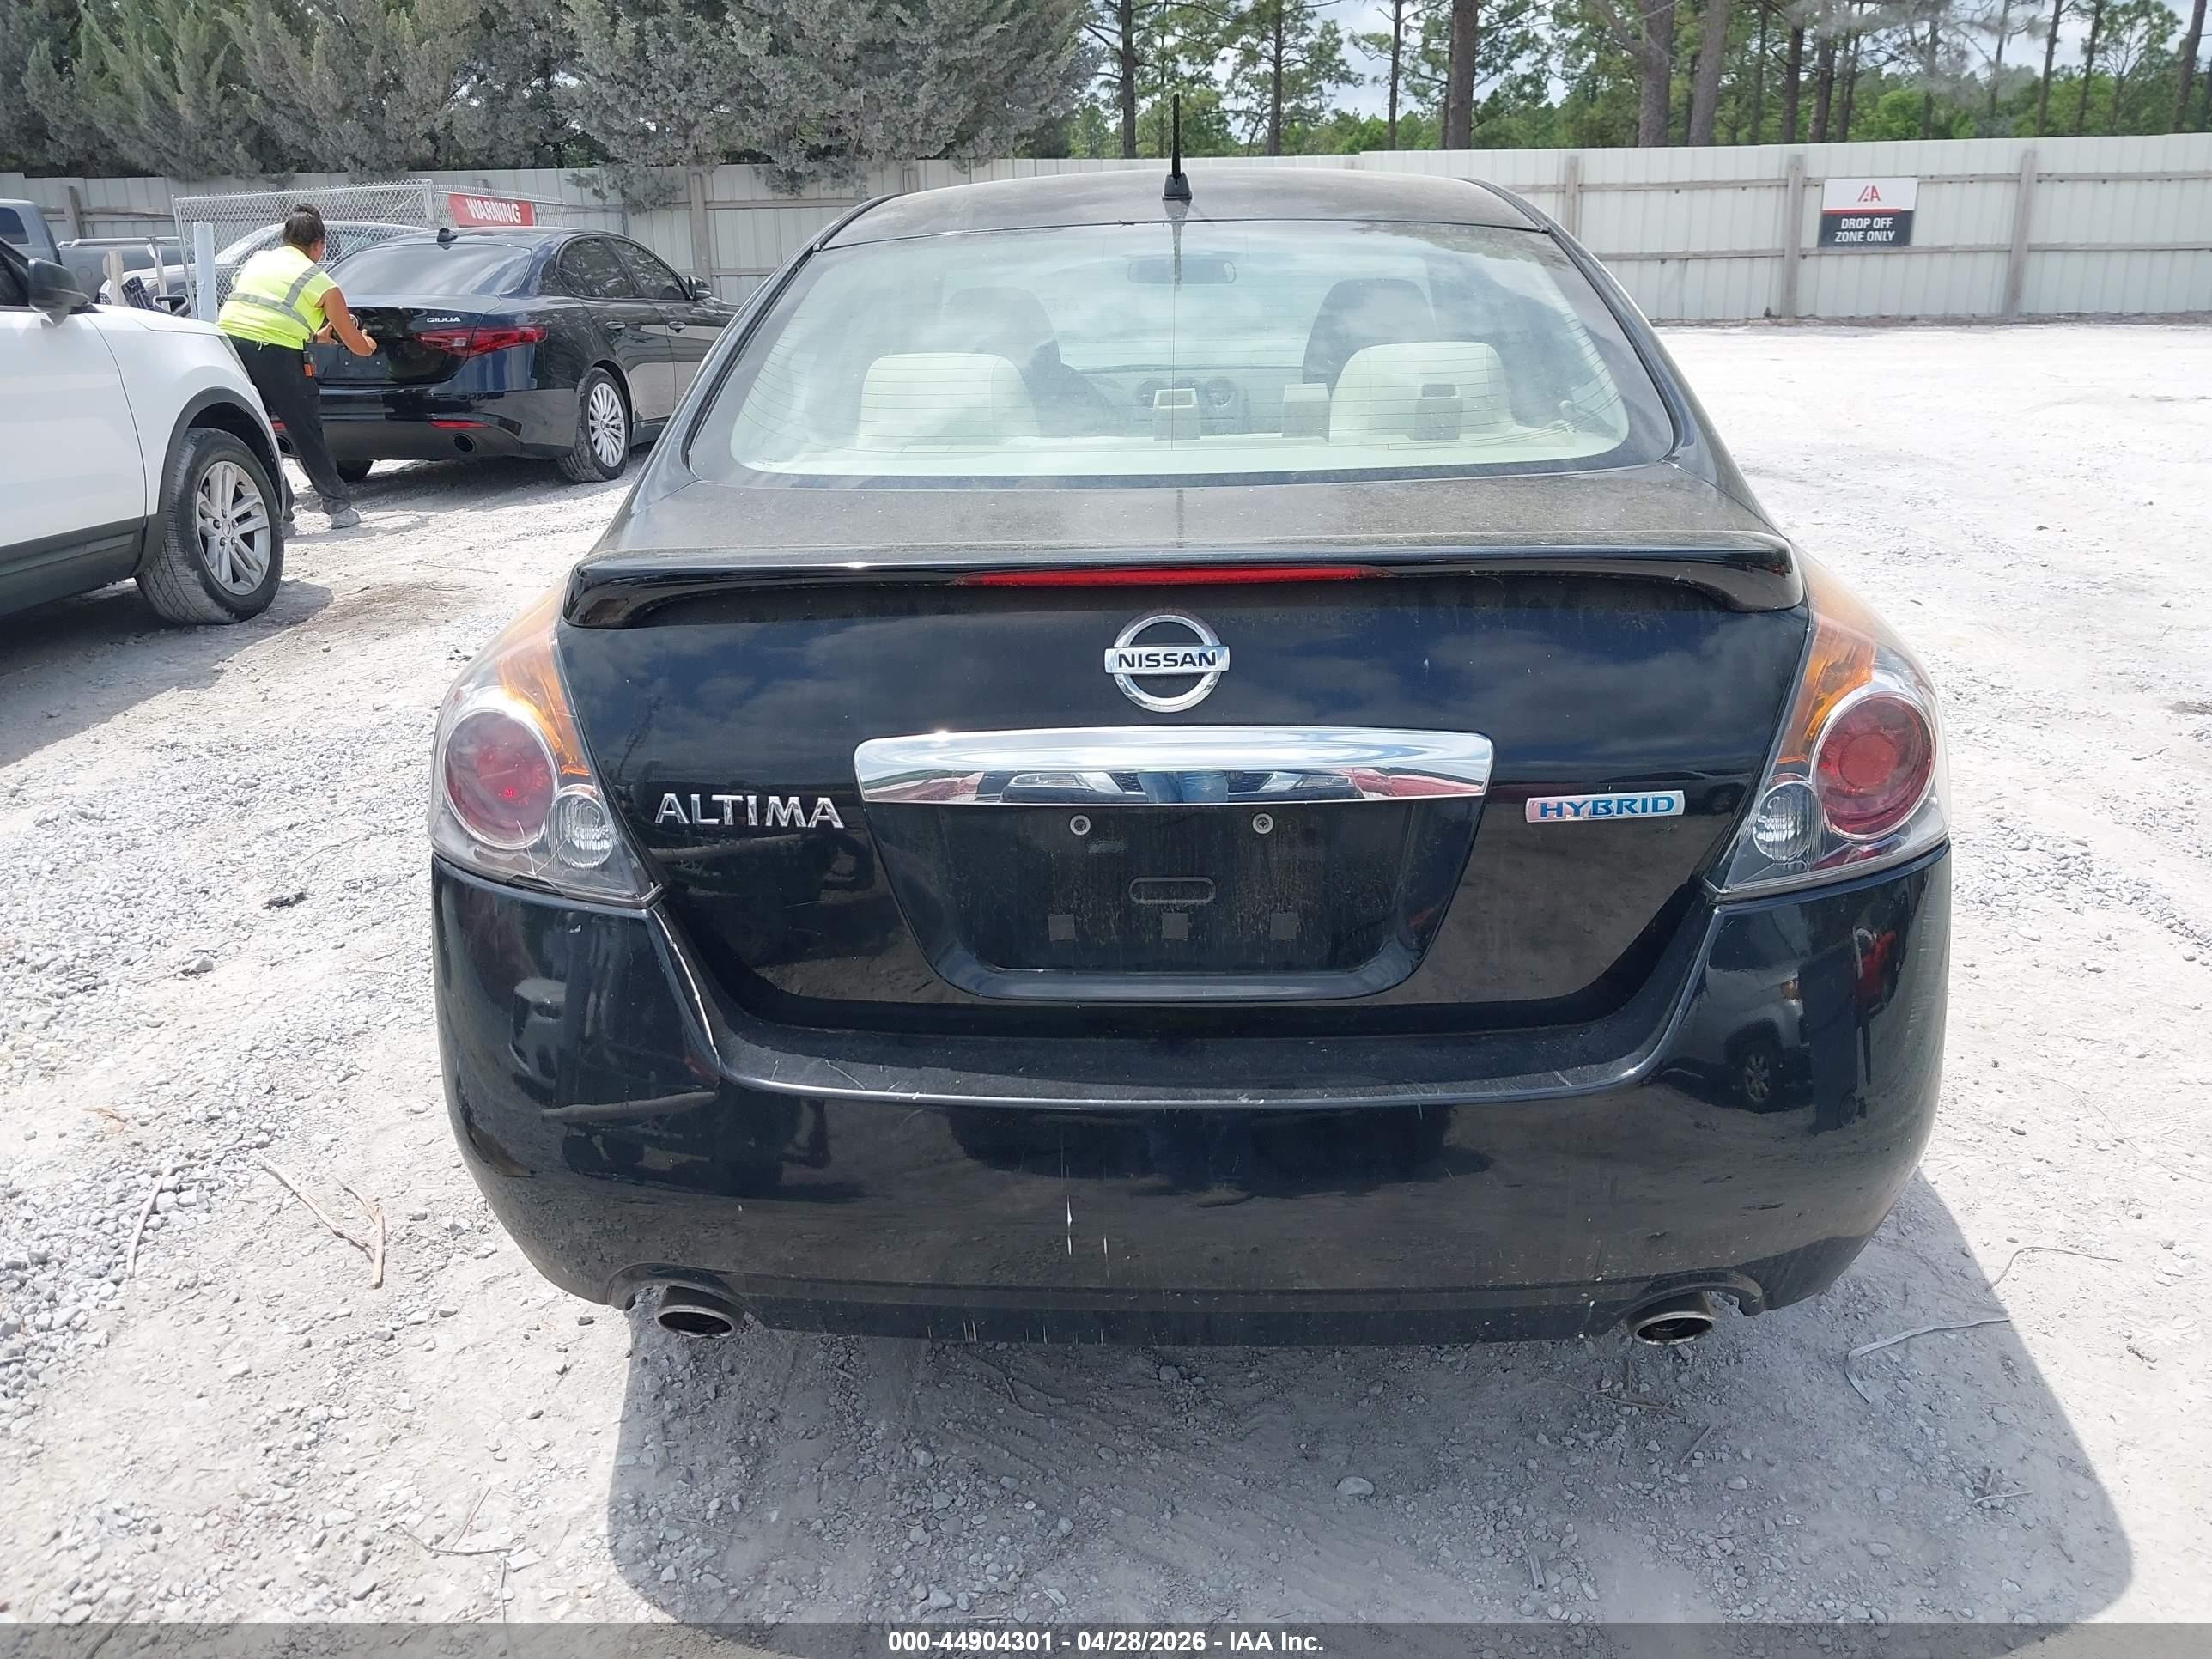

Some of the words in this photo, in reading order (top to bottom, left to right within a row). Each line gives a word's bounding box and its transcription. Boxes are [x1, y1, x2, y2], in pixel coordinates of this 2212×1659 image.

[465, 198, 522, 223] WARNING
[1841, 218, 1870, 229] DROP
[1873, 217, 1893, 229] OFF
[1834, 231, 1865, 242] ZONE
[1866, 230, 1895, 242] ONLY
[1118, 651, 1217, 668] NISSAN
[654, 793, 845, 829] ALTIMA
[1540, 796, 1675, 818] HYBRID
